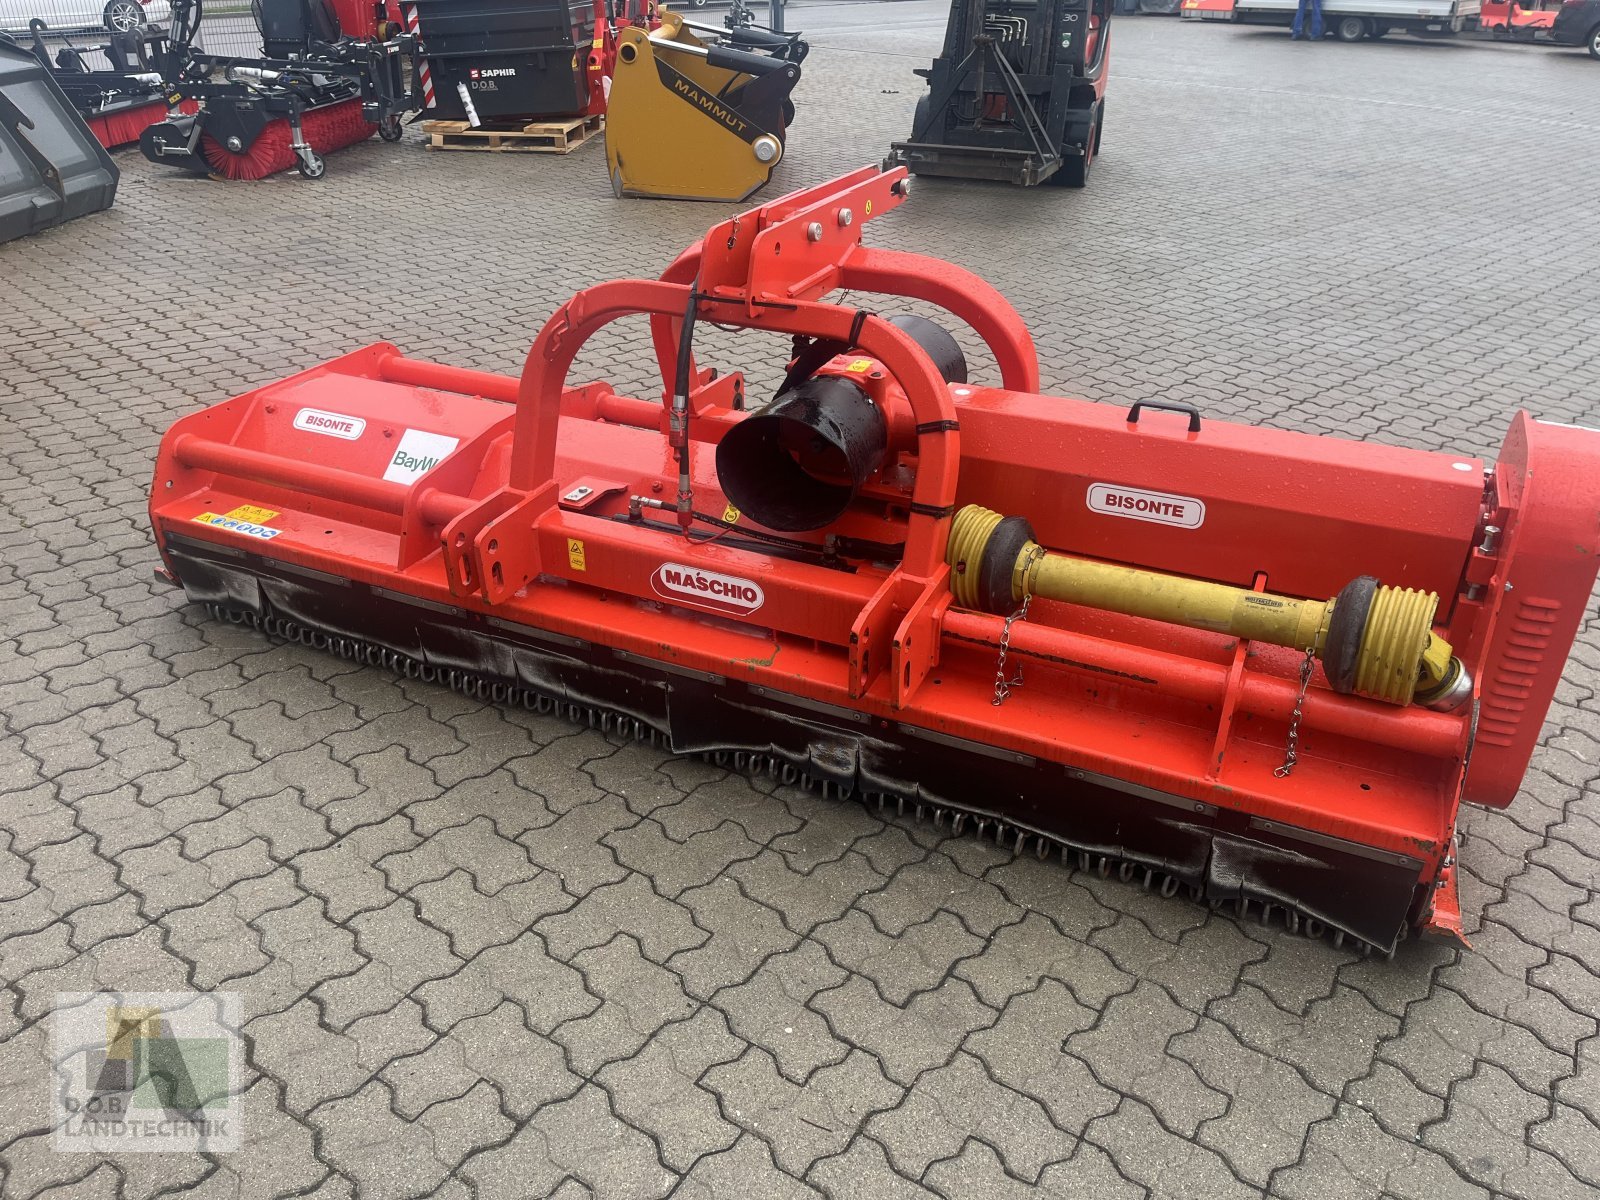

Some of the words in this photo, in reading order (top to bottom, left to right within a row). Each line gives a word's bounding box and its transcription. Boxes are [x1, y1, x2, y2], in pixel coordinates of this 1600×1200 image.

[1062, 13, 1079, 22] 30
[481, 68, 516, 78] SAPHIR
[674, 79, 747, 132] MAMMUT
[305, 415, 354, 433] BISONTE
[1105, 493, 1185, 518] BISONTE
